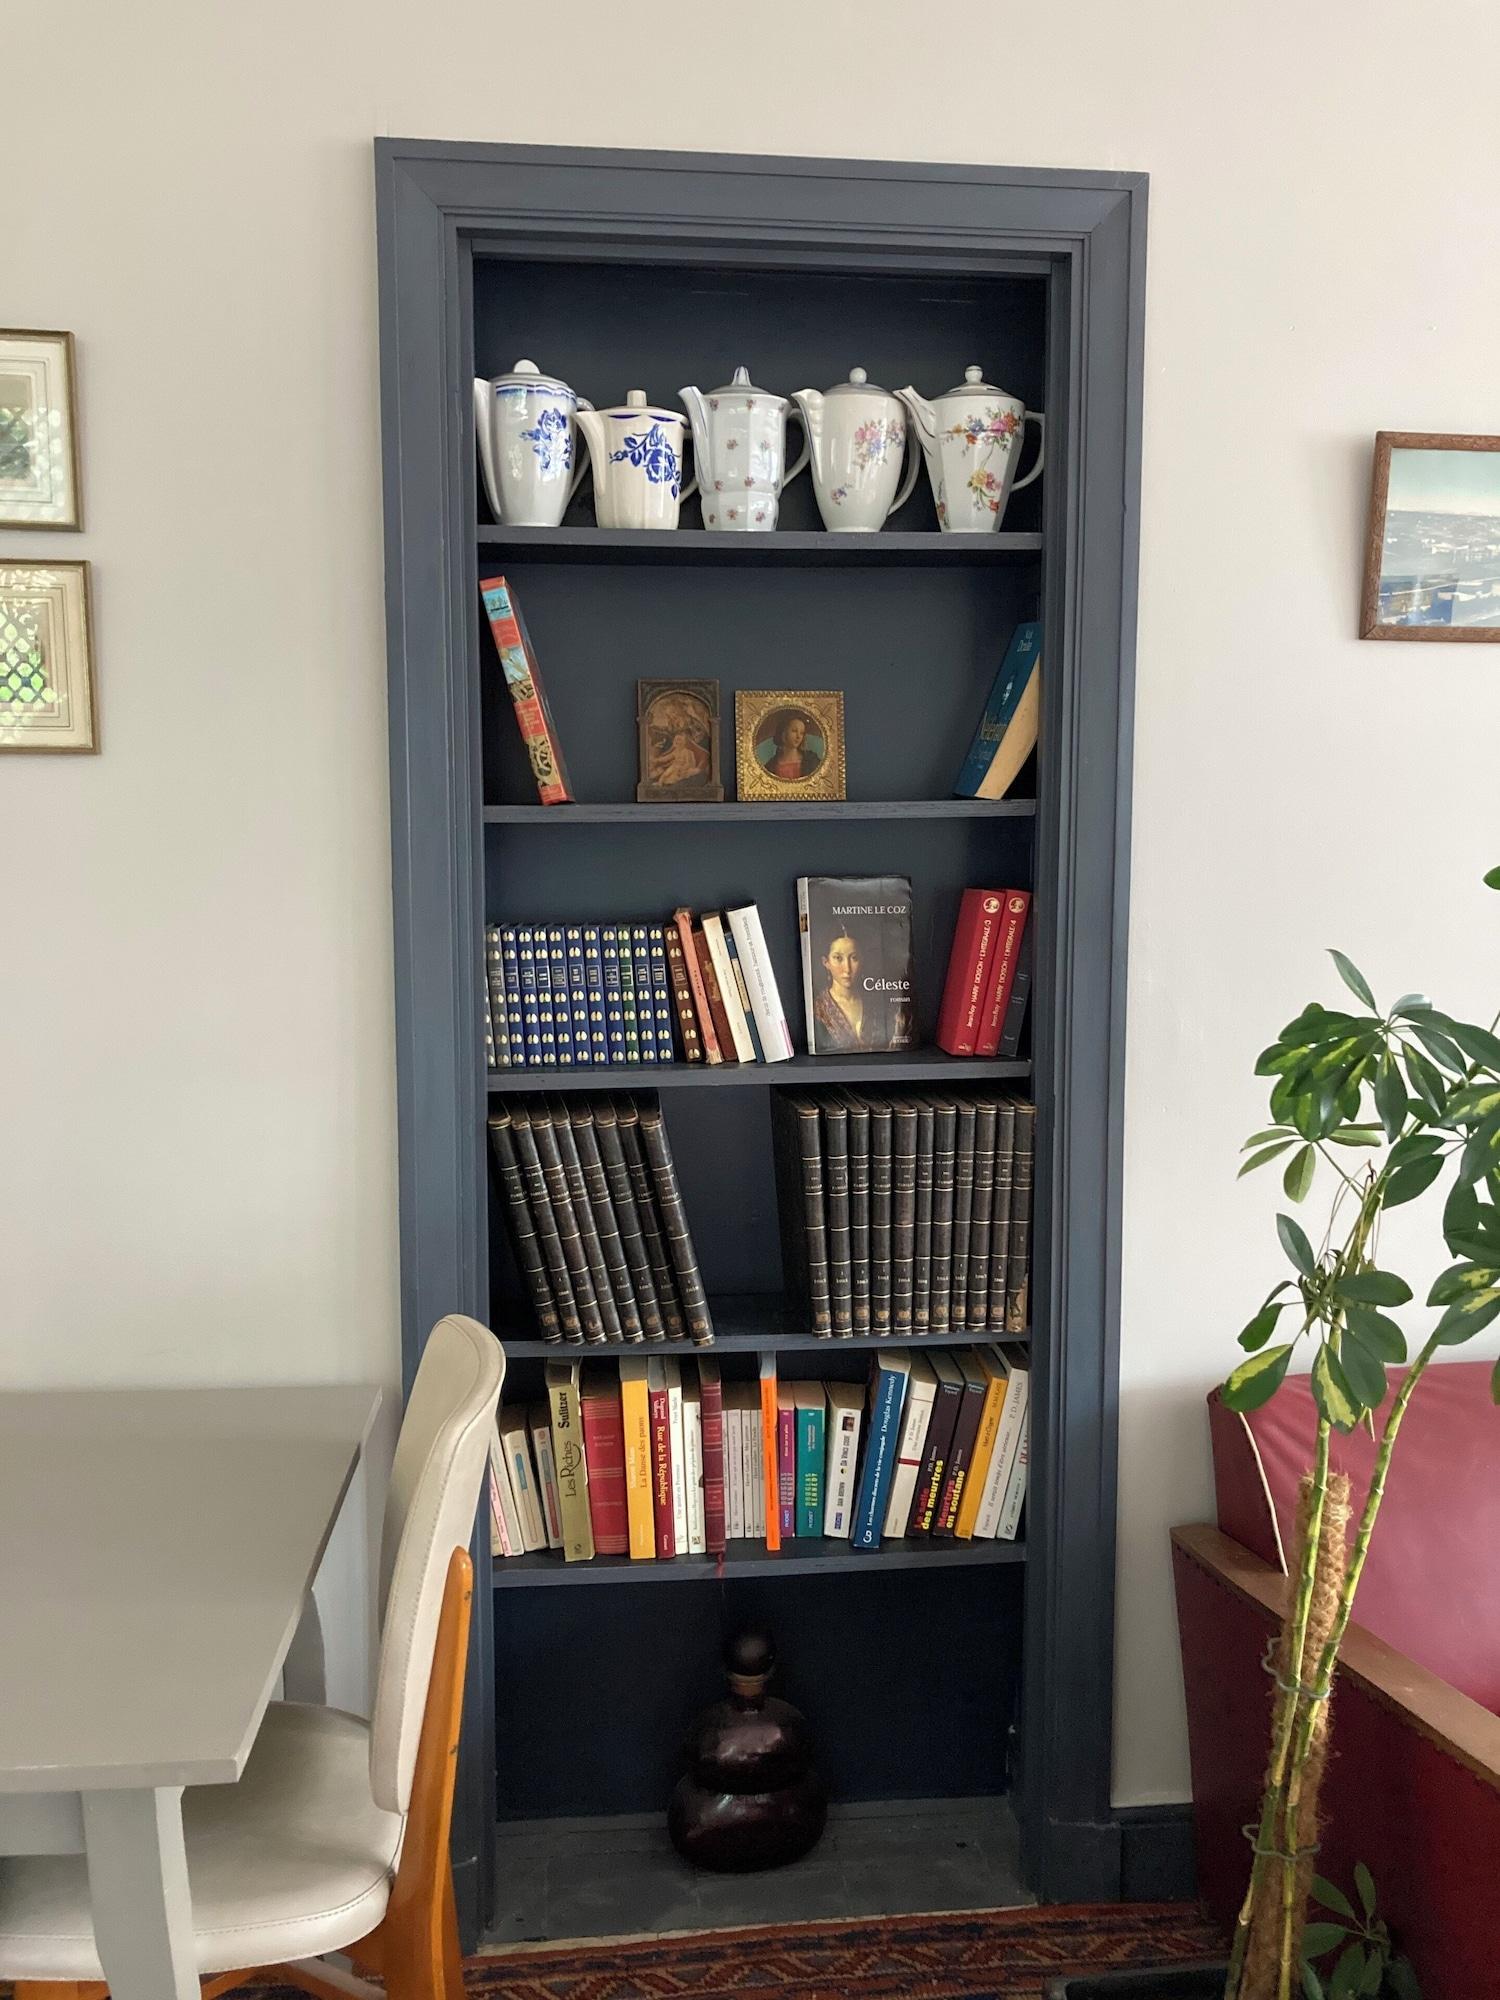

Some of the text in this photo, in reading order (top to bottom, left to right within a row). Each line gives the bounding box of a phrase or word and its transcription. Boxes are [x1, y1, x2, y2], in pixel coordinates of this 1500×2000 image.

[833, 906, 873, 914] MARTINE
[863, 978, 909, 991] Céleste
[971, 985, 979, 1002] HARRY
[881, 1374, 897, 1432] Douglas Kennedy
[1011, 1382, 1023, 1404] JAMES
[558, 1392, 570, 1428] Sulitzer
[1009, 1405, 1017, 1413] D.
[657, 1426, 665, 1442] Rue
[842, 1435, 850, 1446] CODE
[658, 1443, 665, 1453] de
[841, 1447, 849, 1459] VINCI
[877, 1435, 886, 1458] conjugale
[560, 1440, 581, 1497] Les Riches
[638, 1454, 647, 1476] Danse
[640, 1479, 647, 1488] La
[657, 1464, 667, 1506] République
[837, 1482, 845, 1497] BROWN
[871, 1477, 881, 1496] discrets
[921, 1460, 944, 1529] des meurtres
[938, 1480, 955, 1527] Meurtres
[946, 1470, 965, 1528] en soutane
[868, 1496, 877, 1517] charmes
[914, 1487, 929, 1528] La salle
